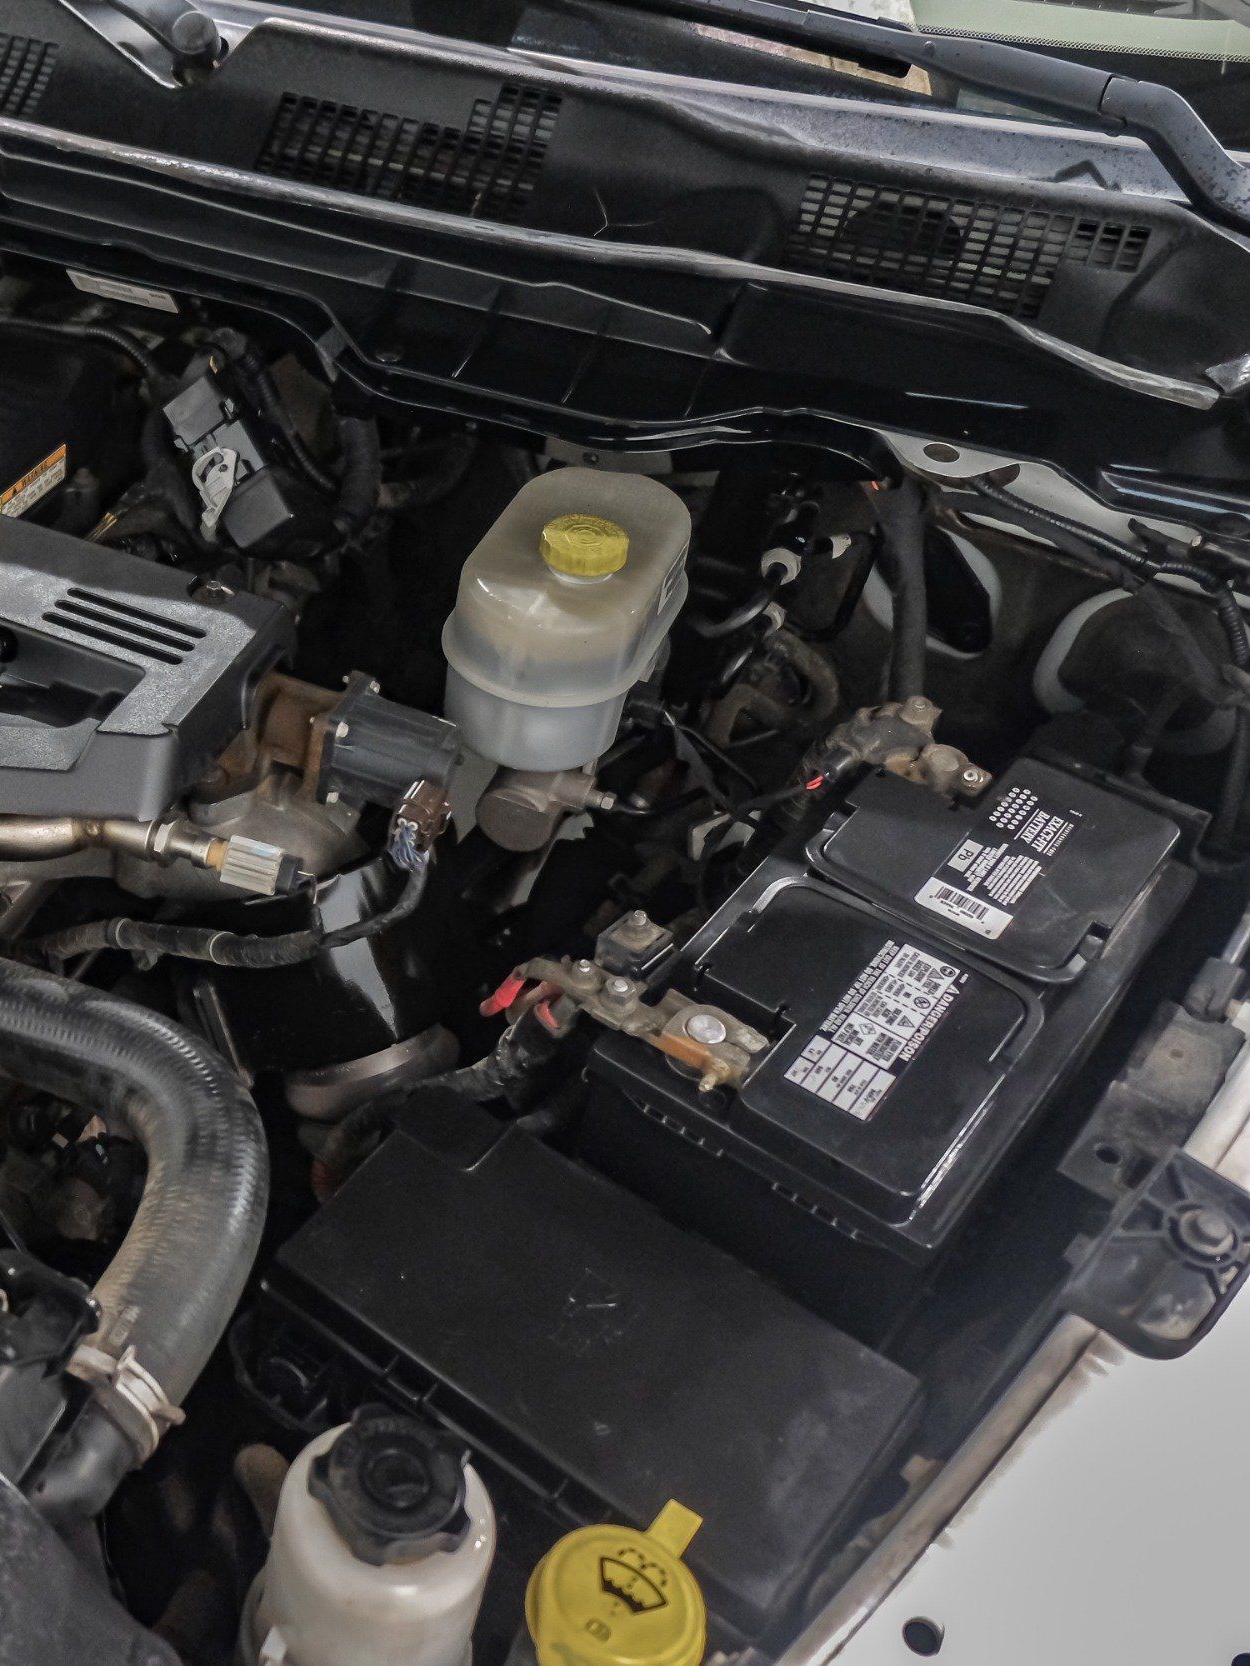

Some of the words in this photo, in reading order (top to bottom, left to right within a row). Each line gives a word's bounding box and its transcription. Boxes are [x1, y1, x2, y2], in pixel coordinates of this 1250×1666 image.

[1019, 810, 1050, 844] BATTERY
[1030, 815, 1064, 852] EXACT-FIT
[958, 848, 974, 862] Pb
[898, 992, 953, 1061] DANGER/POISON
